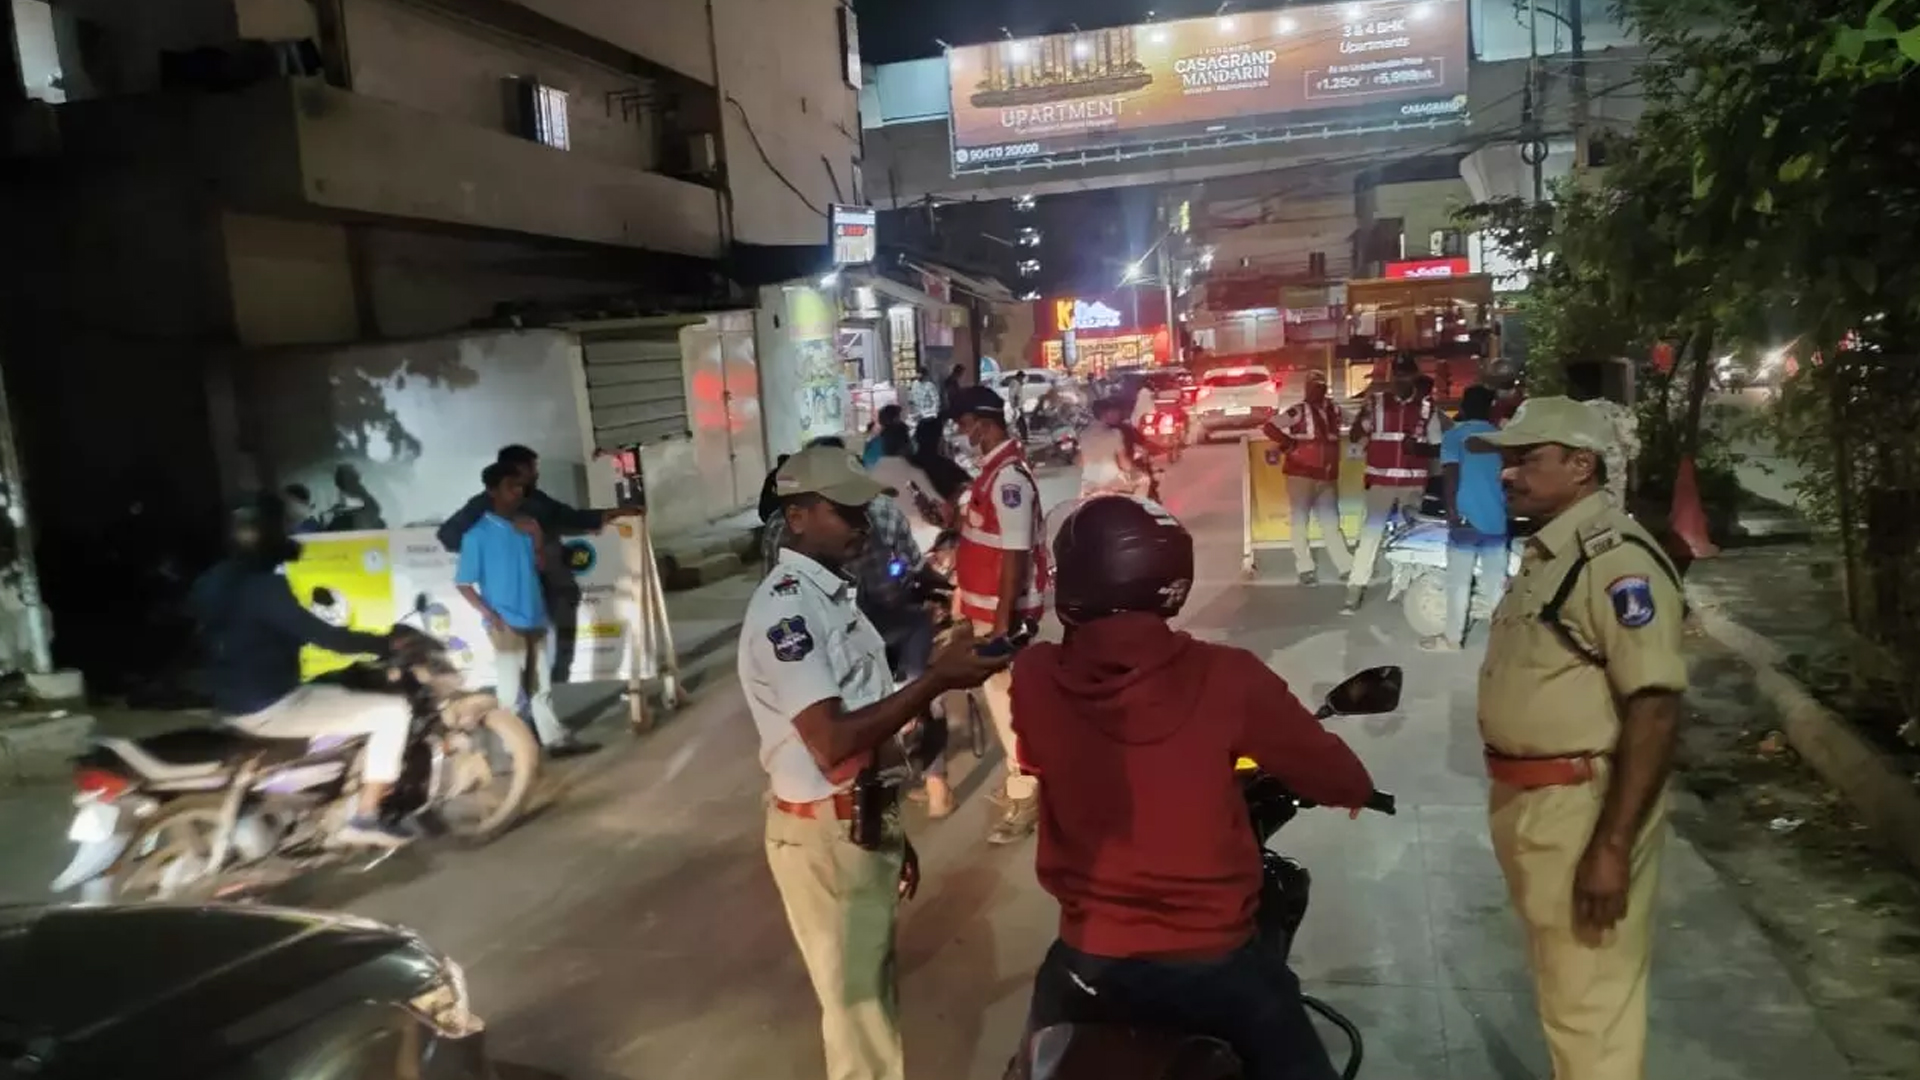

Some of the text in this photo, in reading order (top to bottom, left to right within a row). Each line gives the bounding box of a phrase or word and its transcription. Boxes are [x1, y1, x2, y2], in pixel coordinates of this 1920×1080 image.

[1173, 49, 1277, 74] CASAGRAND
[1182, 65, 1270, 87] MANDARIN
[1000, 97, 1125, 128] UPARTMENT
